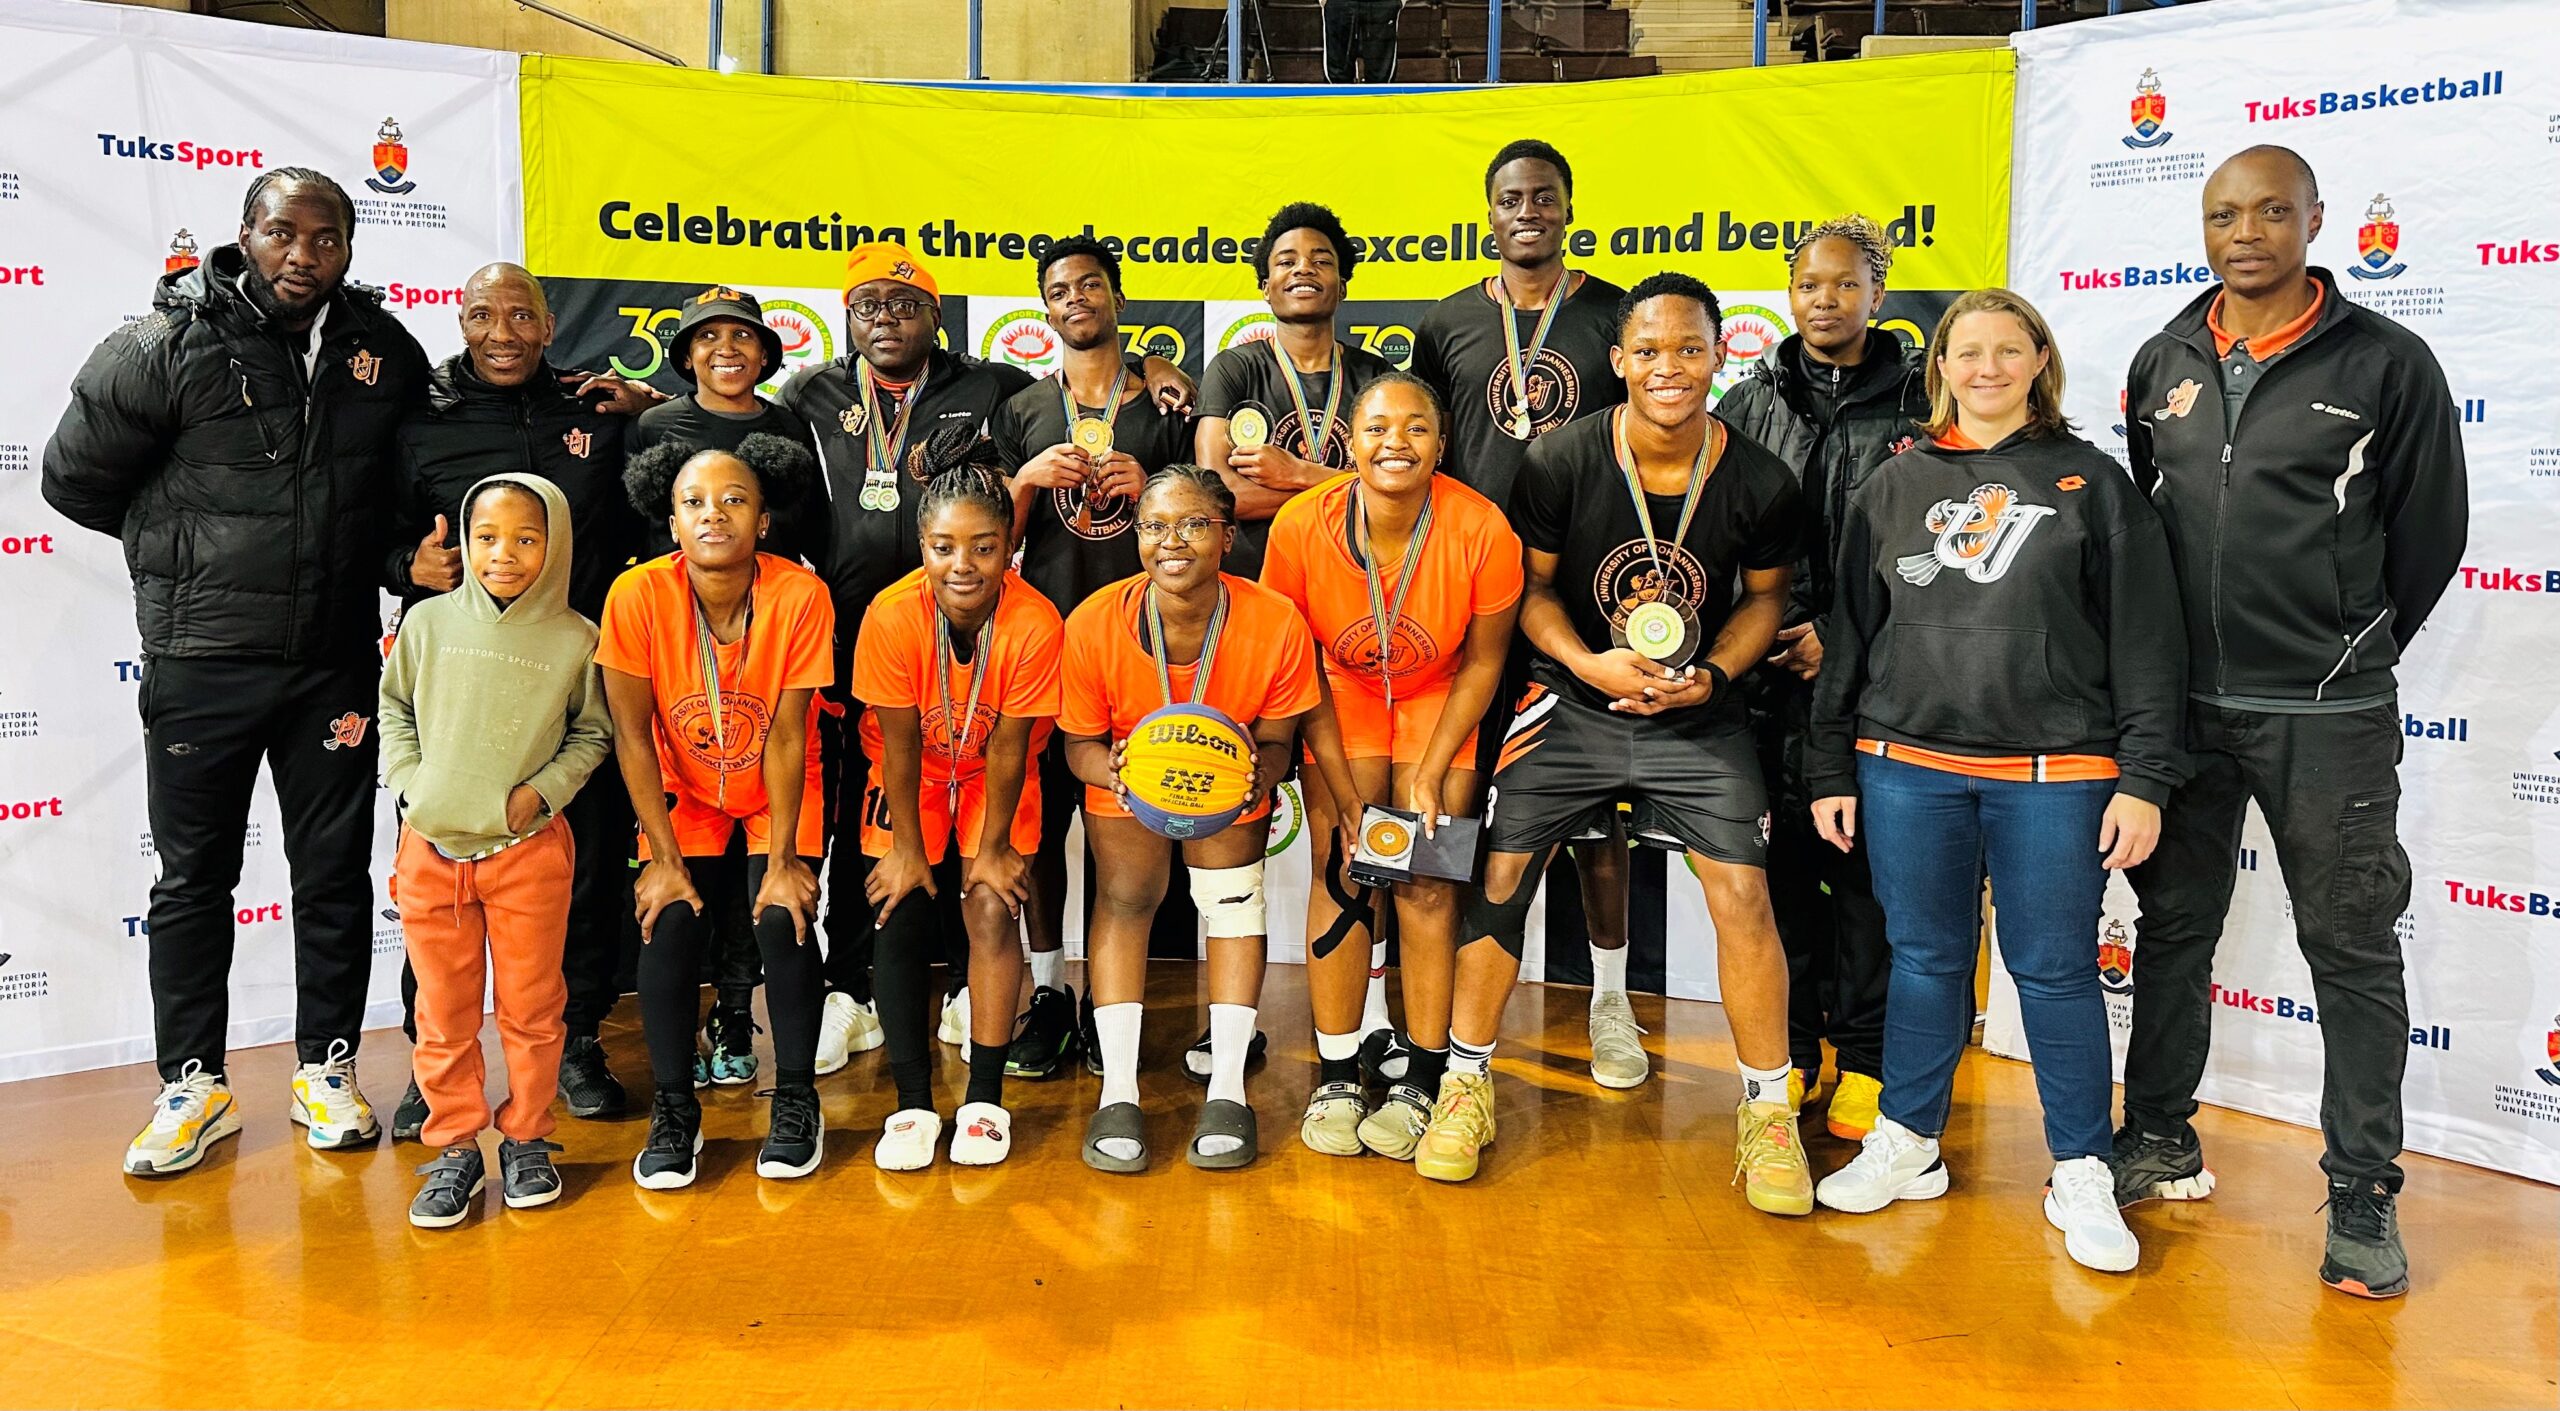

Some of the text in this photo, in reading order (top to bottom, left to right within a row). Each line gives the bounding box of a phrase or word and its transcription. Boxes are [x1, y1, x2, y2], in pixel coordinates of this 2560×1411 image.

[2245, 70, 2503, 123] TuksBasketball
[98, 133, 263, 170] TuksSport
[2091, 158, 2144, 170] UNIVERSITEIT
[2165, 152, 2205, 162] PRETORIA
[2091, 167, 2142, 179] UNIVERSITY
[2161, 161, 2205, 172] PRETORIA
[2091, 177, 2144, 188] YUNIBESITHI
[2161, 171, 2205, 181] PRETORIA
[357, 208, 387, 217] ERSITY
[405, 211, 446, 220] PRETORIA
[391, 201, 406, 209] VAN
[409, 203, 446, 212] PRETORIA
[355, 217, 390, 226] BESITHI
[406, 219, 446, 229] PRETORIA
[918, 219, 1050, 260] three
[1347, 223, 1597, 262] excellee
[1610, 211, 1704, 256] and
[1718, 204, 1936, 262] beyd!
[2059, 261, 2222, 291] TuksBaske
[2375, 289, 2394, 297] VAN
[2396, 287, 2444, 297] PRETORIA
[2374, 300, 2387, 308] OF
[2392, 297, 2444, 307] PRETORIA
[2392, 307, 2443, 317] PRETORIA
[1760, 308, 1791, 336] SOUTH
[796, 305, 825, 331] SOUTH
[823, 331, 834, 362] AFRIC
[982, 310, 1038, 359] IVERSITY SPORT
[1383, 344, 1410, 352] YEARS
[1535, 352, 1576, 409] OHANNESBURG
[1275, 417, 1296, 446] ERSITY
[1600, 544, 1702, 607] UNIVERSITY OF OHANNESBURG
[440, 646, 551, 671] PREHISTORIC SPECIES
[721, 697, 769, 742] OHANNESBURG
[1148, 723, 1238, 760] Wilson
[2513, 771, 2560, 784] UNIVERSI
[2512, 782, 2560, 794] UNIVERS
[2512, 792, 2560, 804] YUNIBES
[1291, 799, 1300, 830] AFRICA
[2, 971, 48, 982] PRETORIA
[2111, 1011, 2121, 1019] OF
[2112, 1003, 2127, 1011] VAN
[2113, 1020, 2123, 1029] YA
[2495, 1104, 2560, 1124] YUNIBESITH
